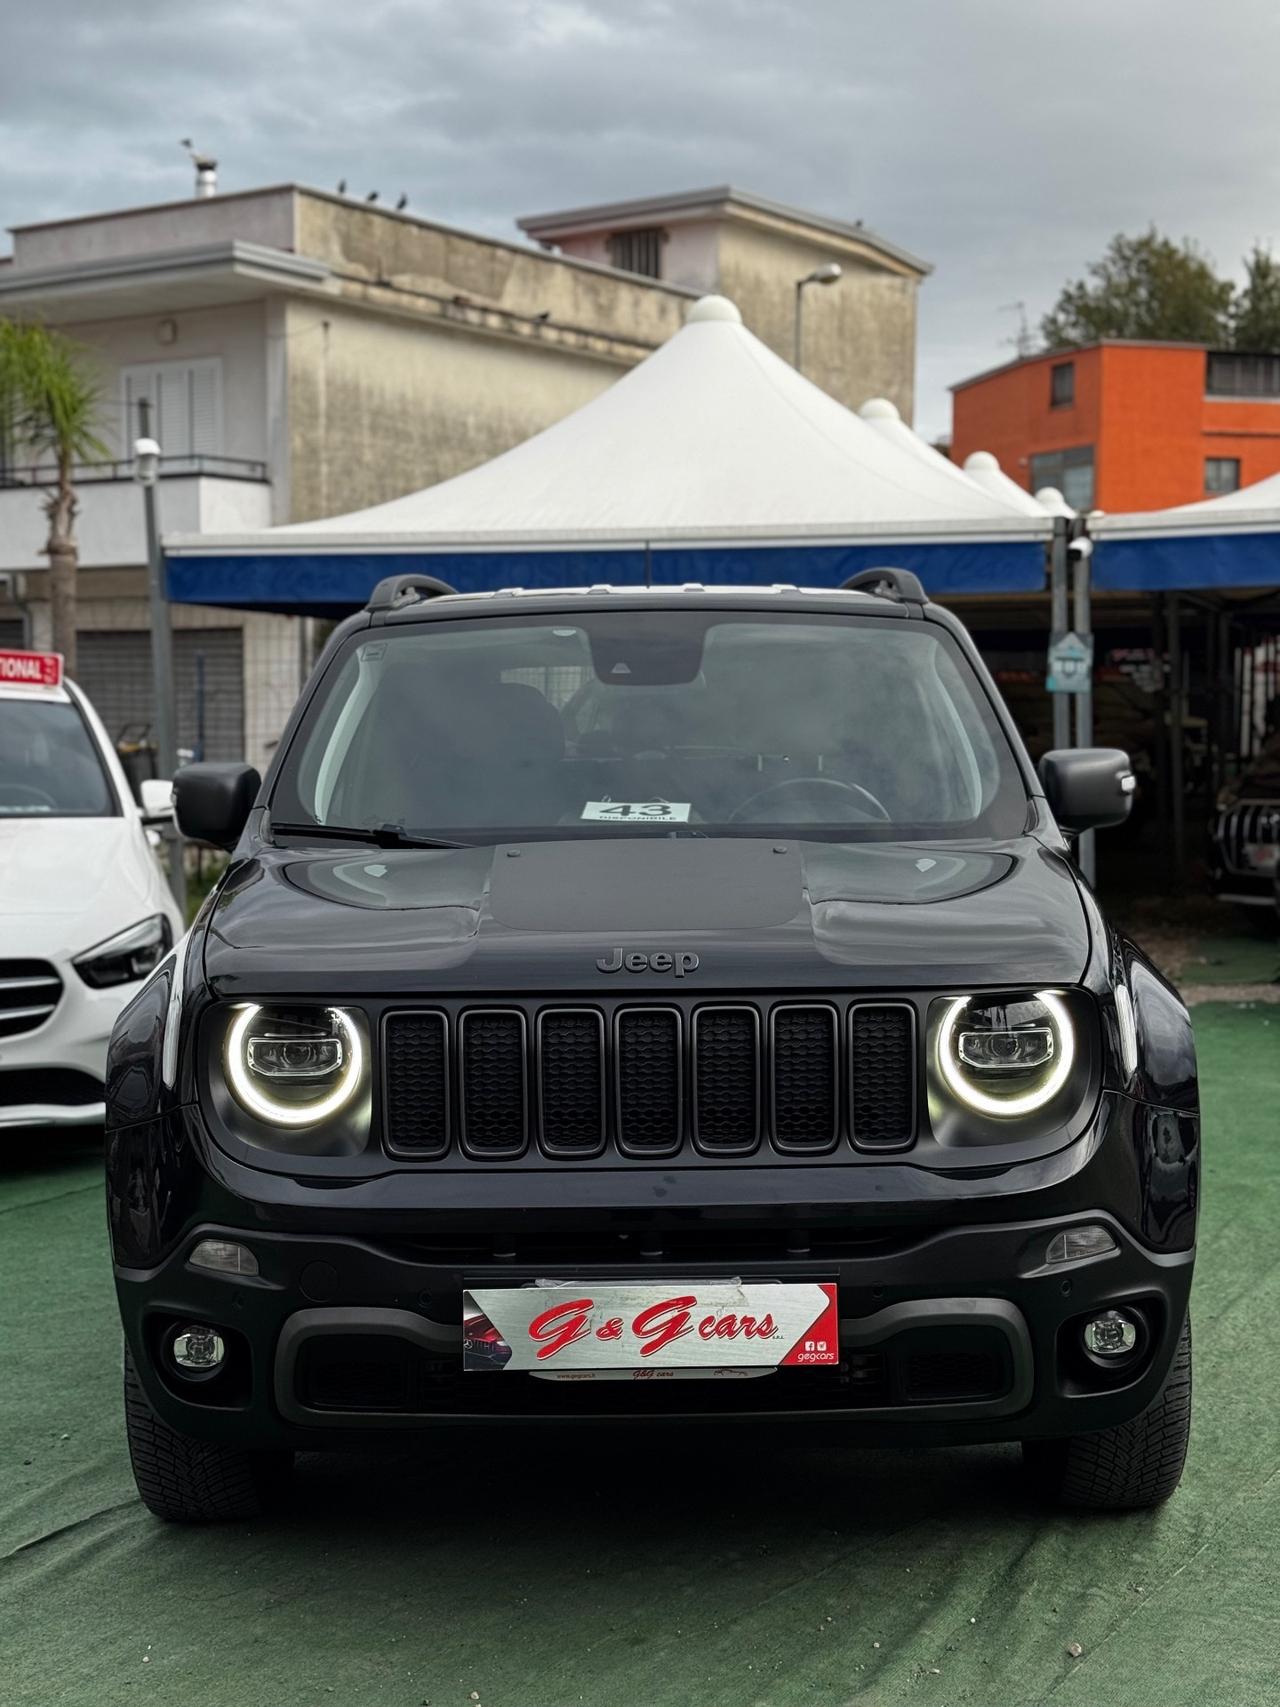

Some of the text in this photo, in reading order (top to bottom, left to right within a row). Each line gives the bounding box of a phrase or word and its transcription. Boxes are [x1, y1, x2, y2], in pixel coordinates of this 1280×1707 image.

[600, 804, 672, 816] 43
[596, 948, 700, 978] Jeep
[528, 1295, 778, 1361] G & G cars
[797, 1352, 835, 1363] gegcars
[656, 1370, 674, 1378] cars
